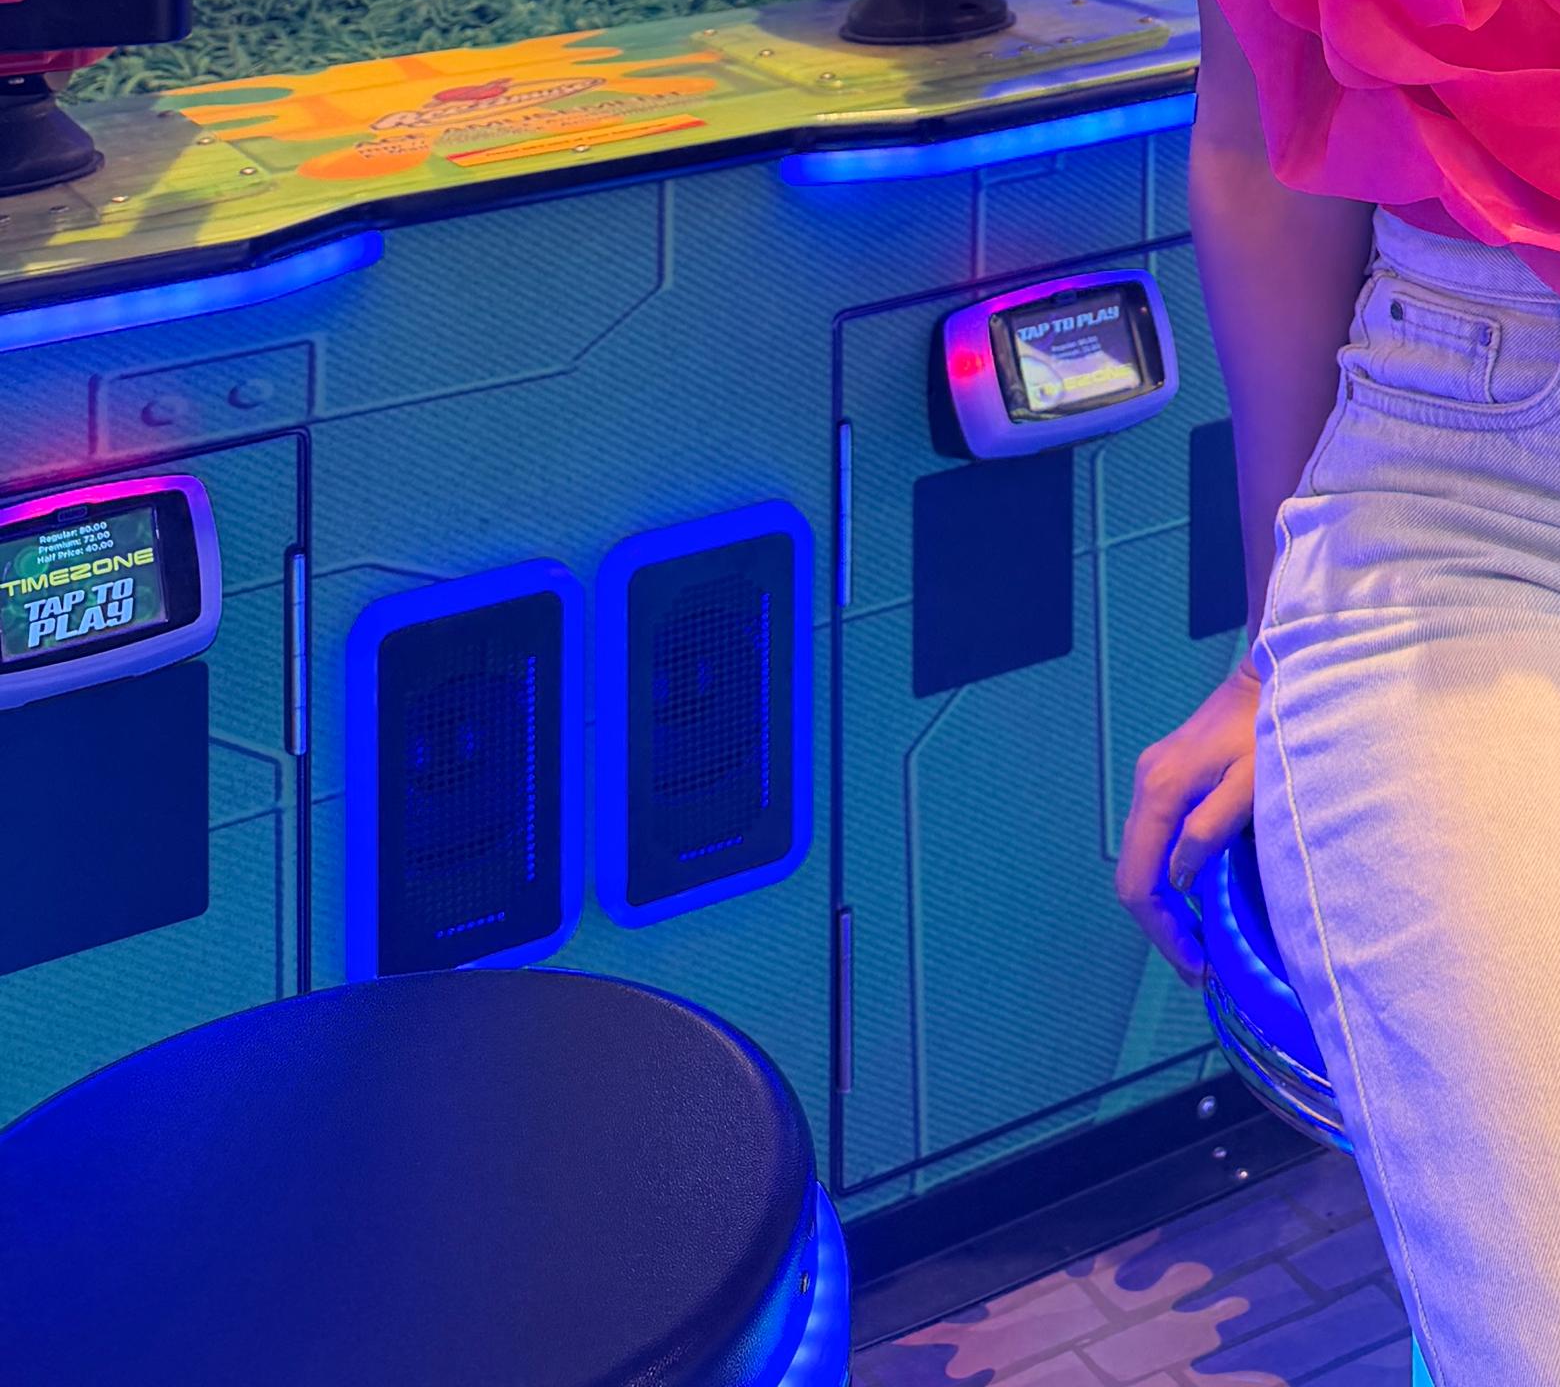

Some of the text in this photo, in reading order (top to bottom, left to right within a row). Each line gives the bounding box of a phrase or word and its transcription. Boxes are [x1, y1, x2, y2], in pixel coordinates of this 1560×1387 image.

[1017, 306, 1120, 341] TAP TO PLAY
[37, 552, 56, 565] Half
[85, 539, 114, 553] 40.00
[38, 539, 82, 554] Premium:
[39, 530, 78, 544] Regular:
[0, 547, 155, 597] TIMEZONE
[24, 577, 134, 622] TAP TO
[28, 597, 134, 648] PLAY
